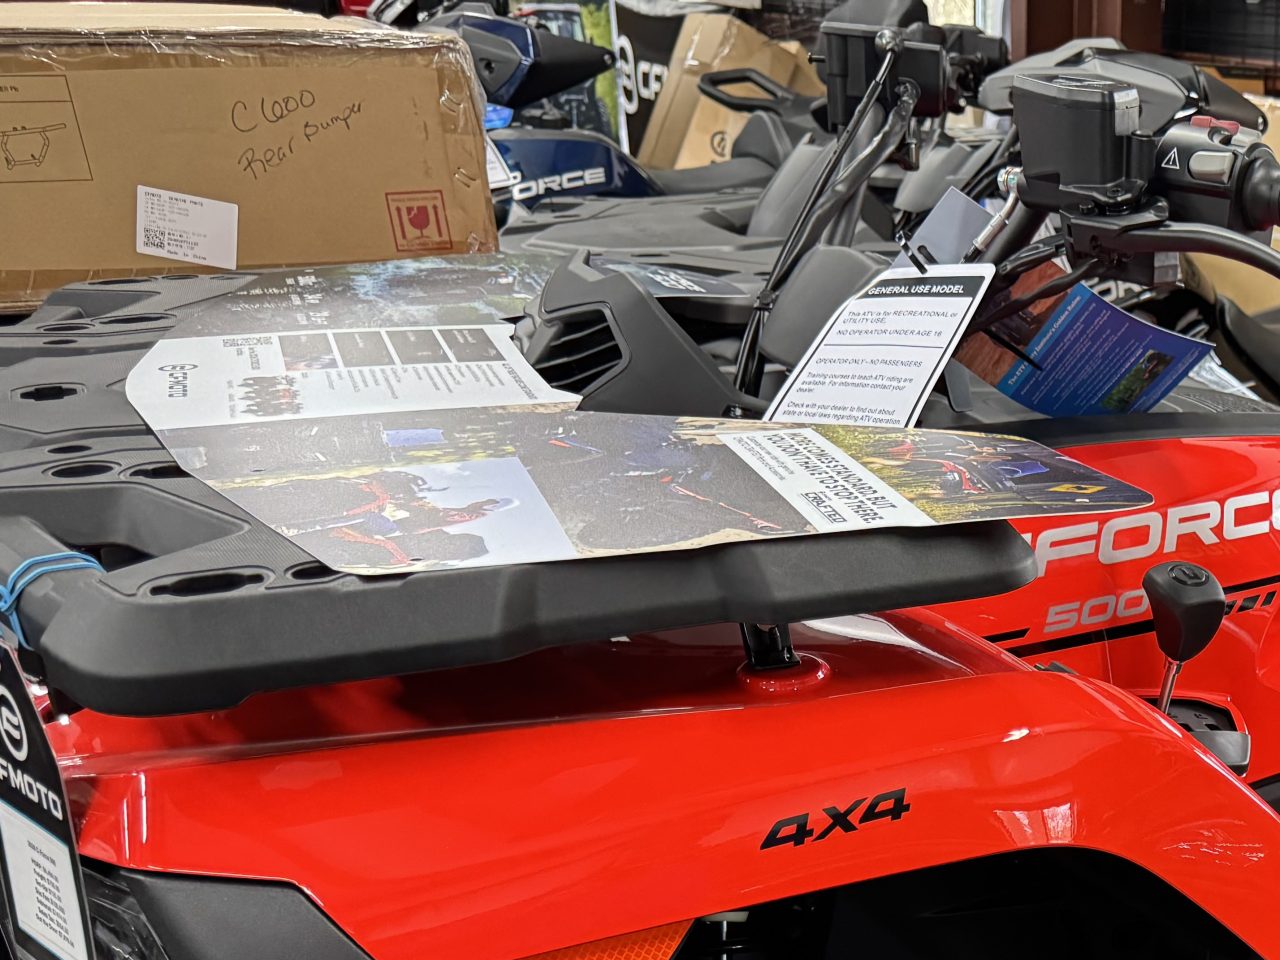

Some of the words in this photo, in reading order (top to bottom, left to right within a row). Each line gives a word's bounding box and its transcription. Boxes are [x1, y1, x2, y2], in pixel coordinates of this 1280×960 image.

[637, 61, 669, 100] CF
[868, 286, 910, 295] GENERAL
[911, 285, 930, 294] USE
[931, 285, 964, 294] MODEL
[892, 310, 949, 318] RECREATIONAL
[816, 357, 849, 365] OPERATOR
[880, 359, 923, 368] PASSENGERS
[859, 414, 872, 423] ATV
[796, 461, 830, 476] HAVE
[803, 446, 840, 464] COMES
[865, 496, 898, 509] BUT
[815, 475, 840, 485] TO
[825, 484, 860, 500] STOP
[804, 491, 848, 523] CRAFTED
[760, 787, 911, 850] 4X4
